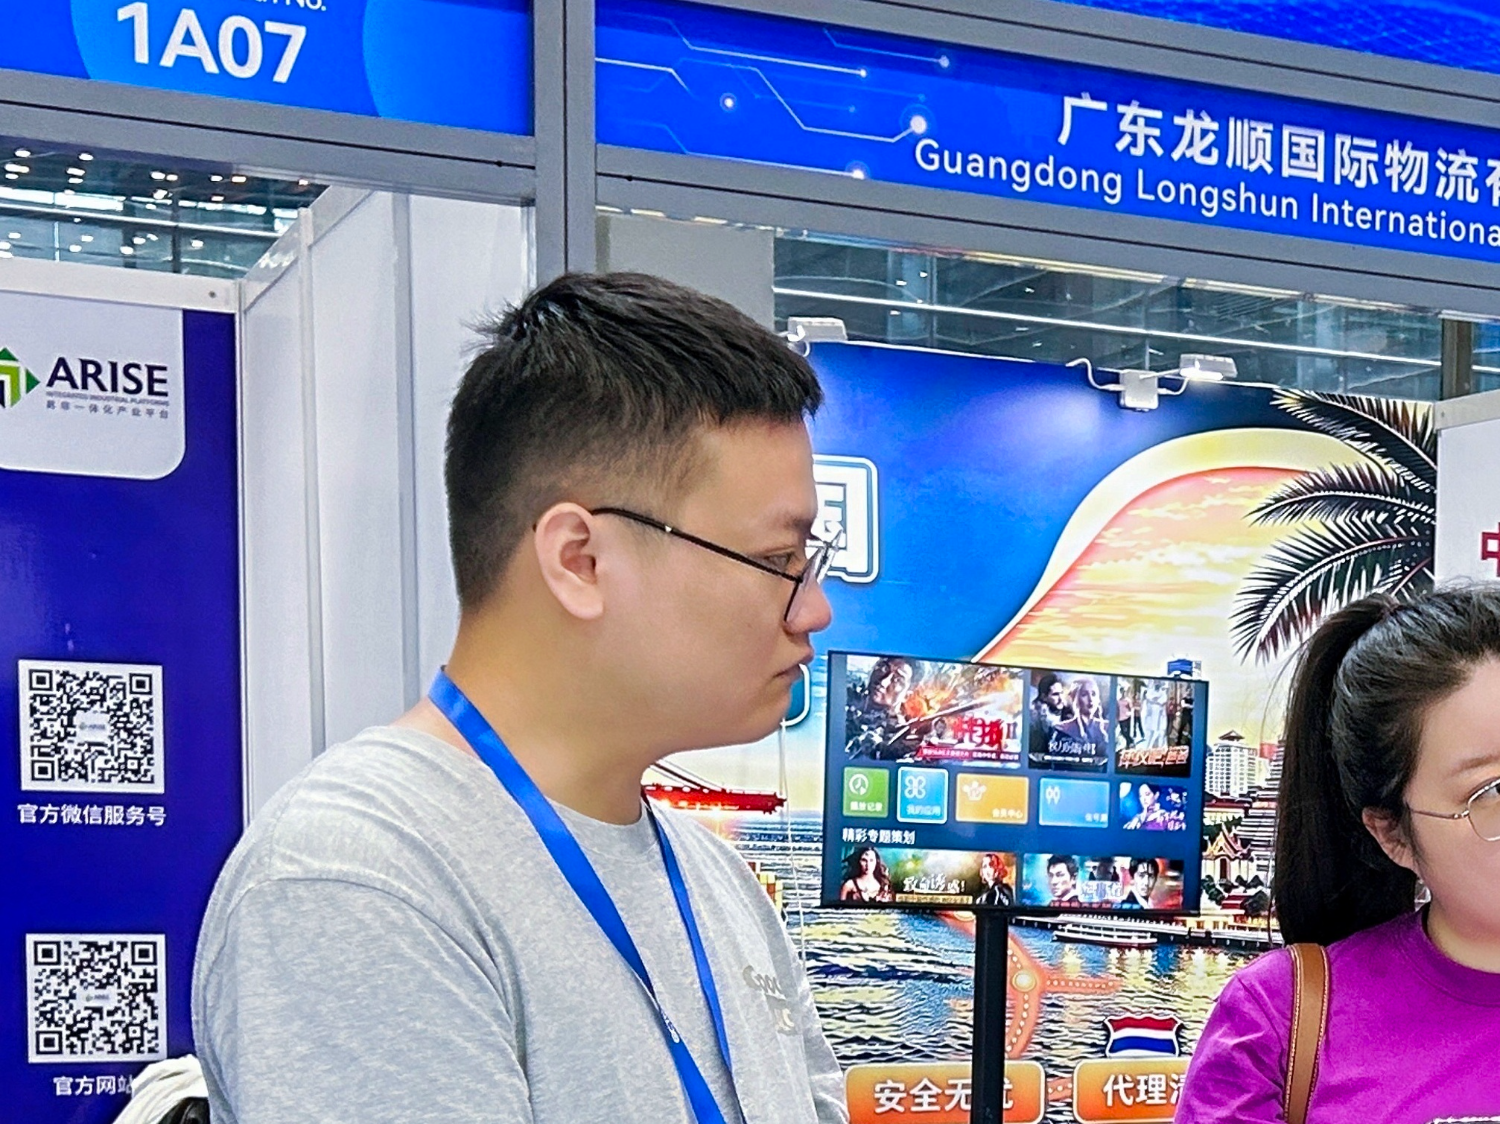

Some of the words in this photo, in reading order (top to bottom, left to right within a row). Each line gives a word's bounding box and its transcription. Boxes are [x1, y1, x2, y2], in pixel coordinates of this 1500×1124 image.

[117, 2, 307, 84] 1A07
[914, 138, 1122, 204] Guangdong
[1136, 168, 1299, 220] Longshun
[46, 356, 168, 397] ARISE
[17, 803, 167, 827] 官方微信服务号
[53, 1074, 132, 1097] 官方网站
